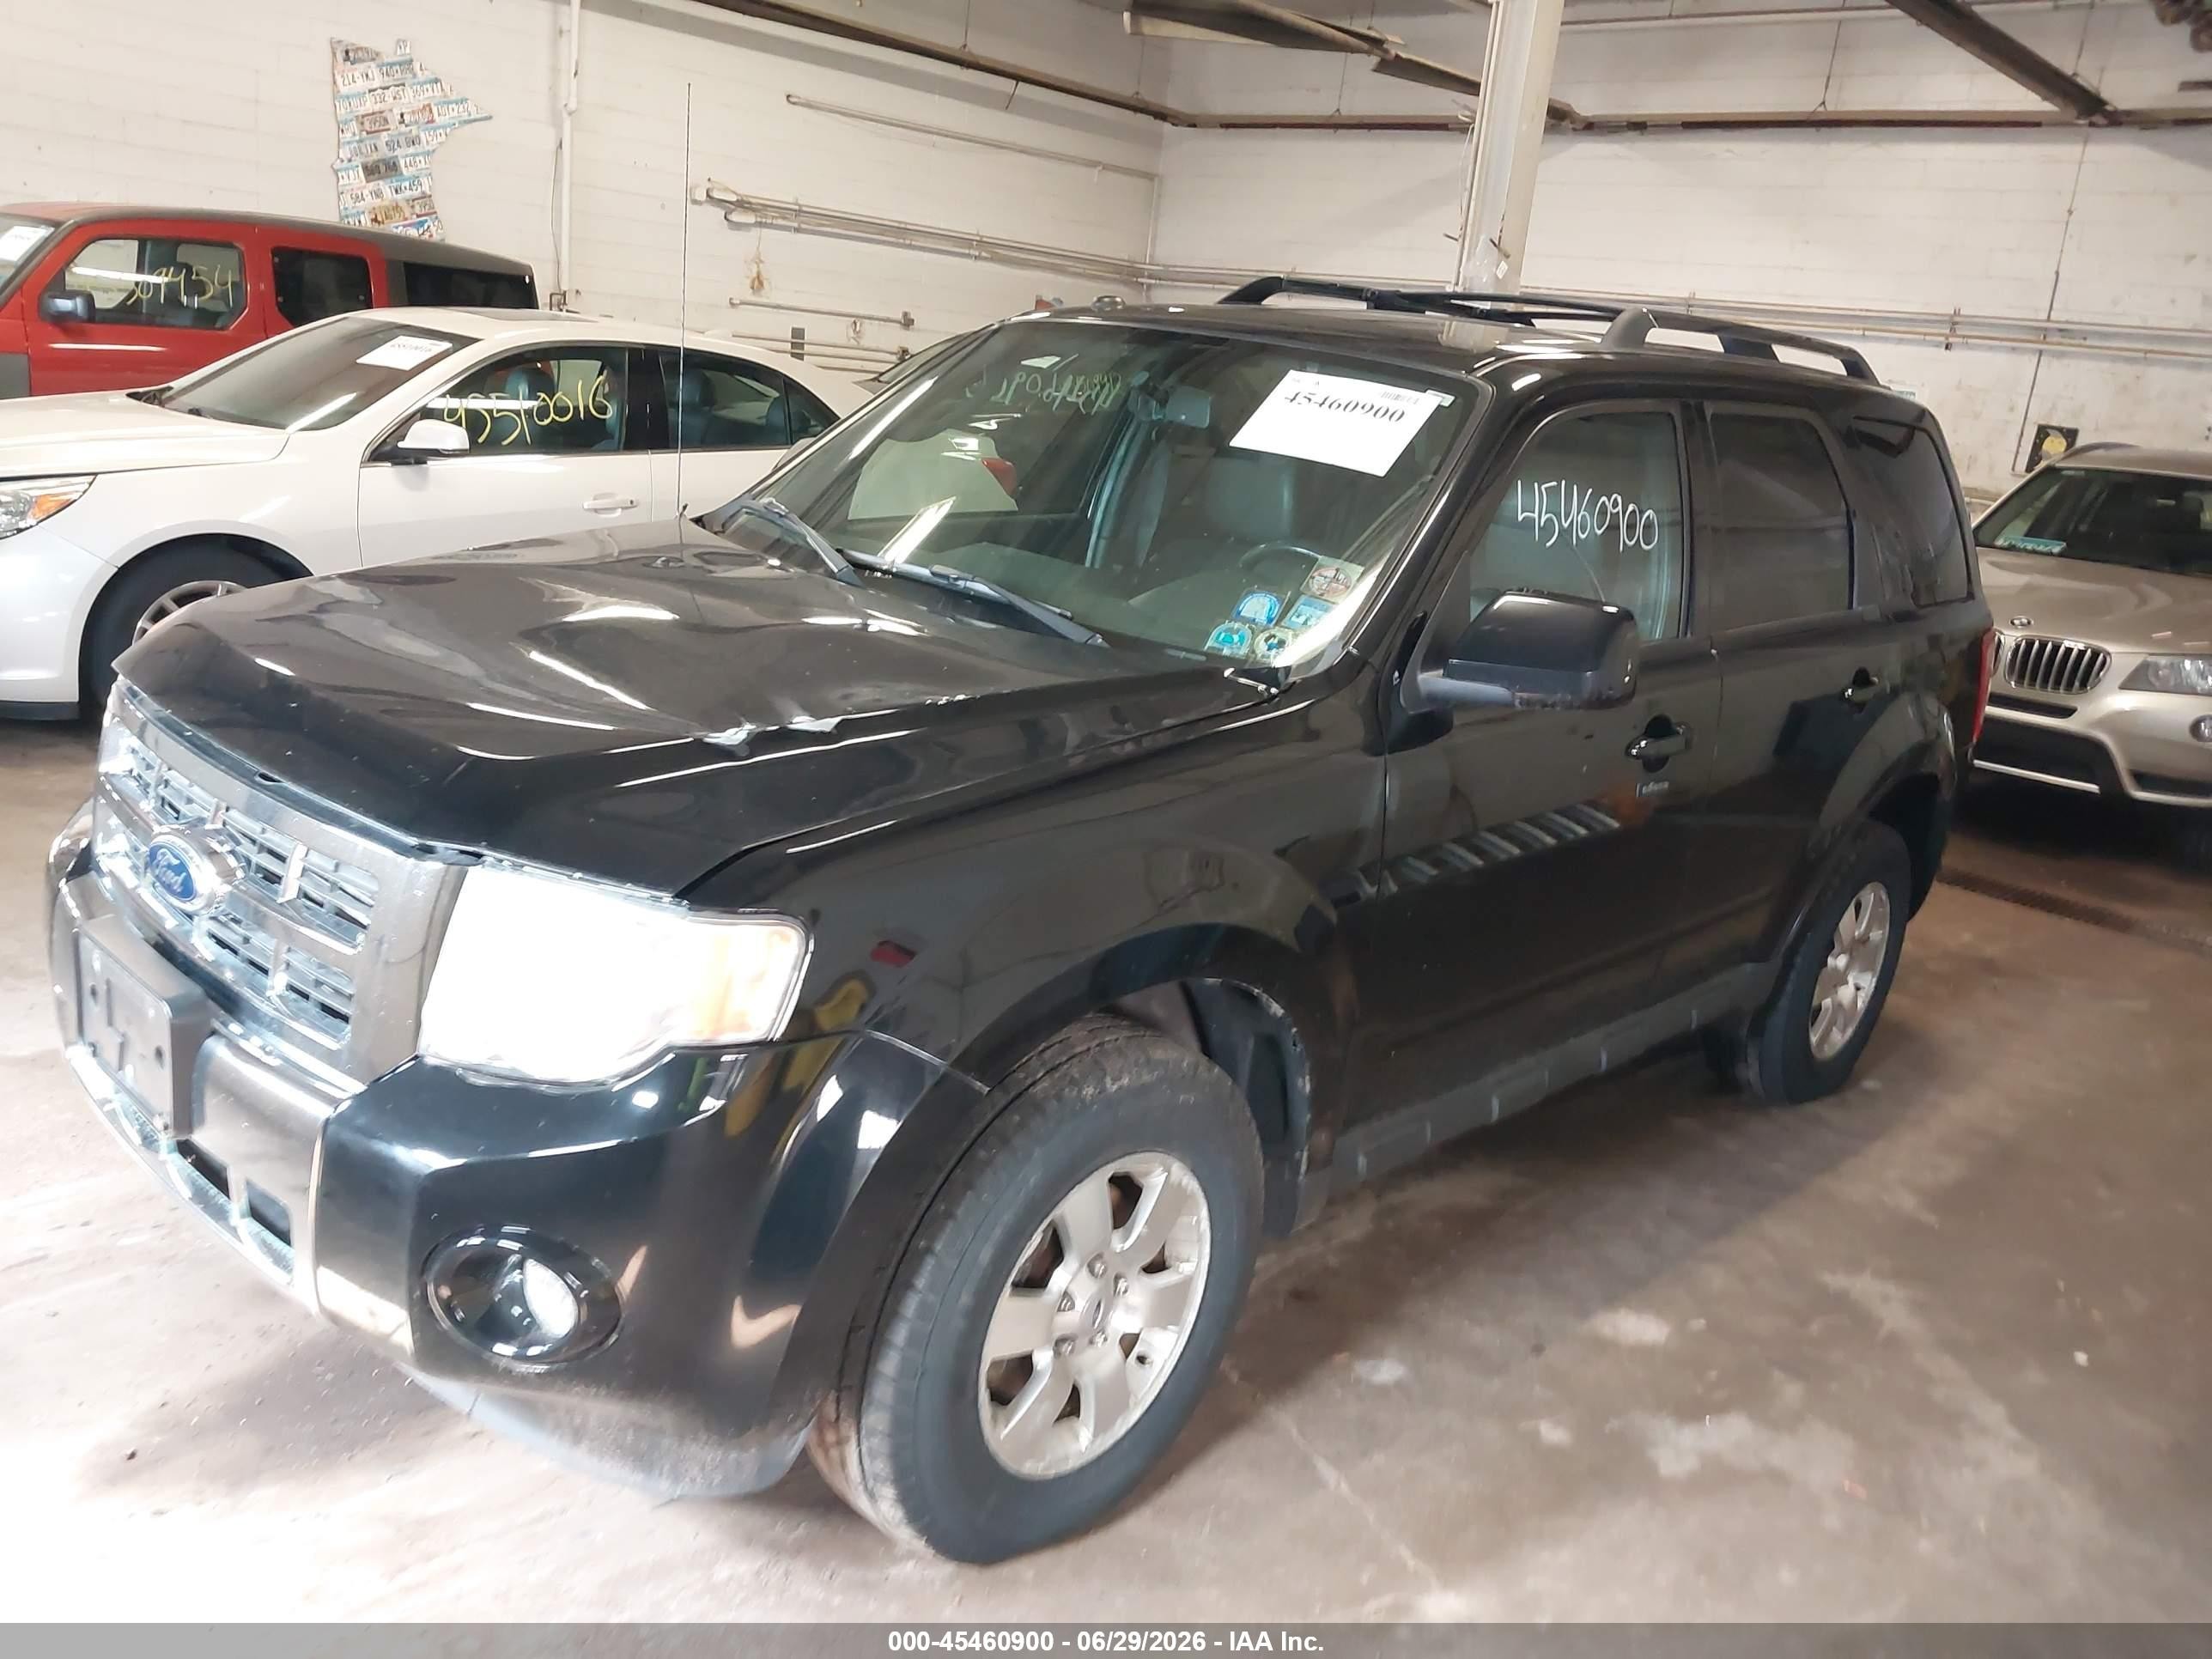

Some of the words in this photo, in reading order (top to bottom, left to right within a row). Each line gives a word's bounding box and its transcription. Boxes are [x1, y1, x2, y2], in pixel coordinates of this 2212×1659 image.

[443, 369, 612, 446] 45510016
[1284, 391, 1406, 422] 45460900
[1517, 479, 1659, 552] 45460900
